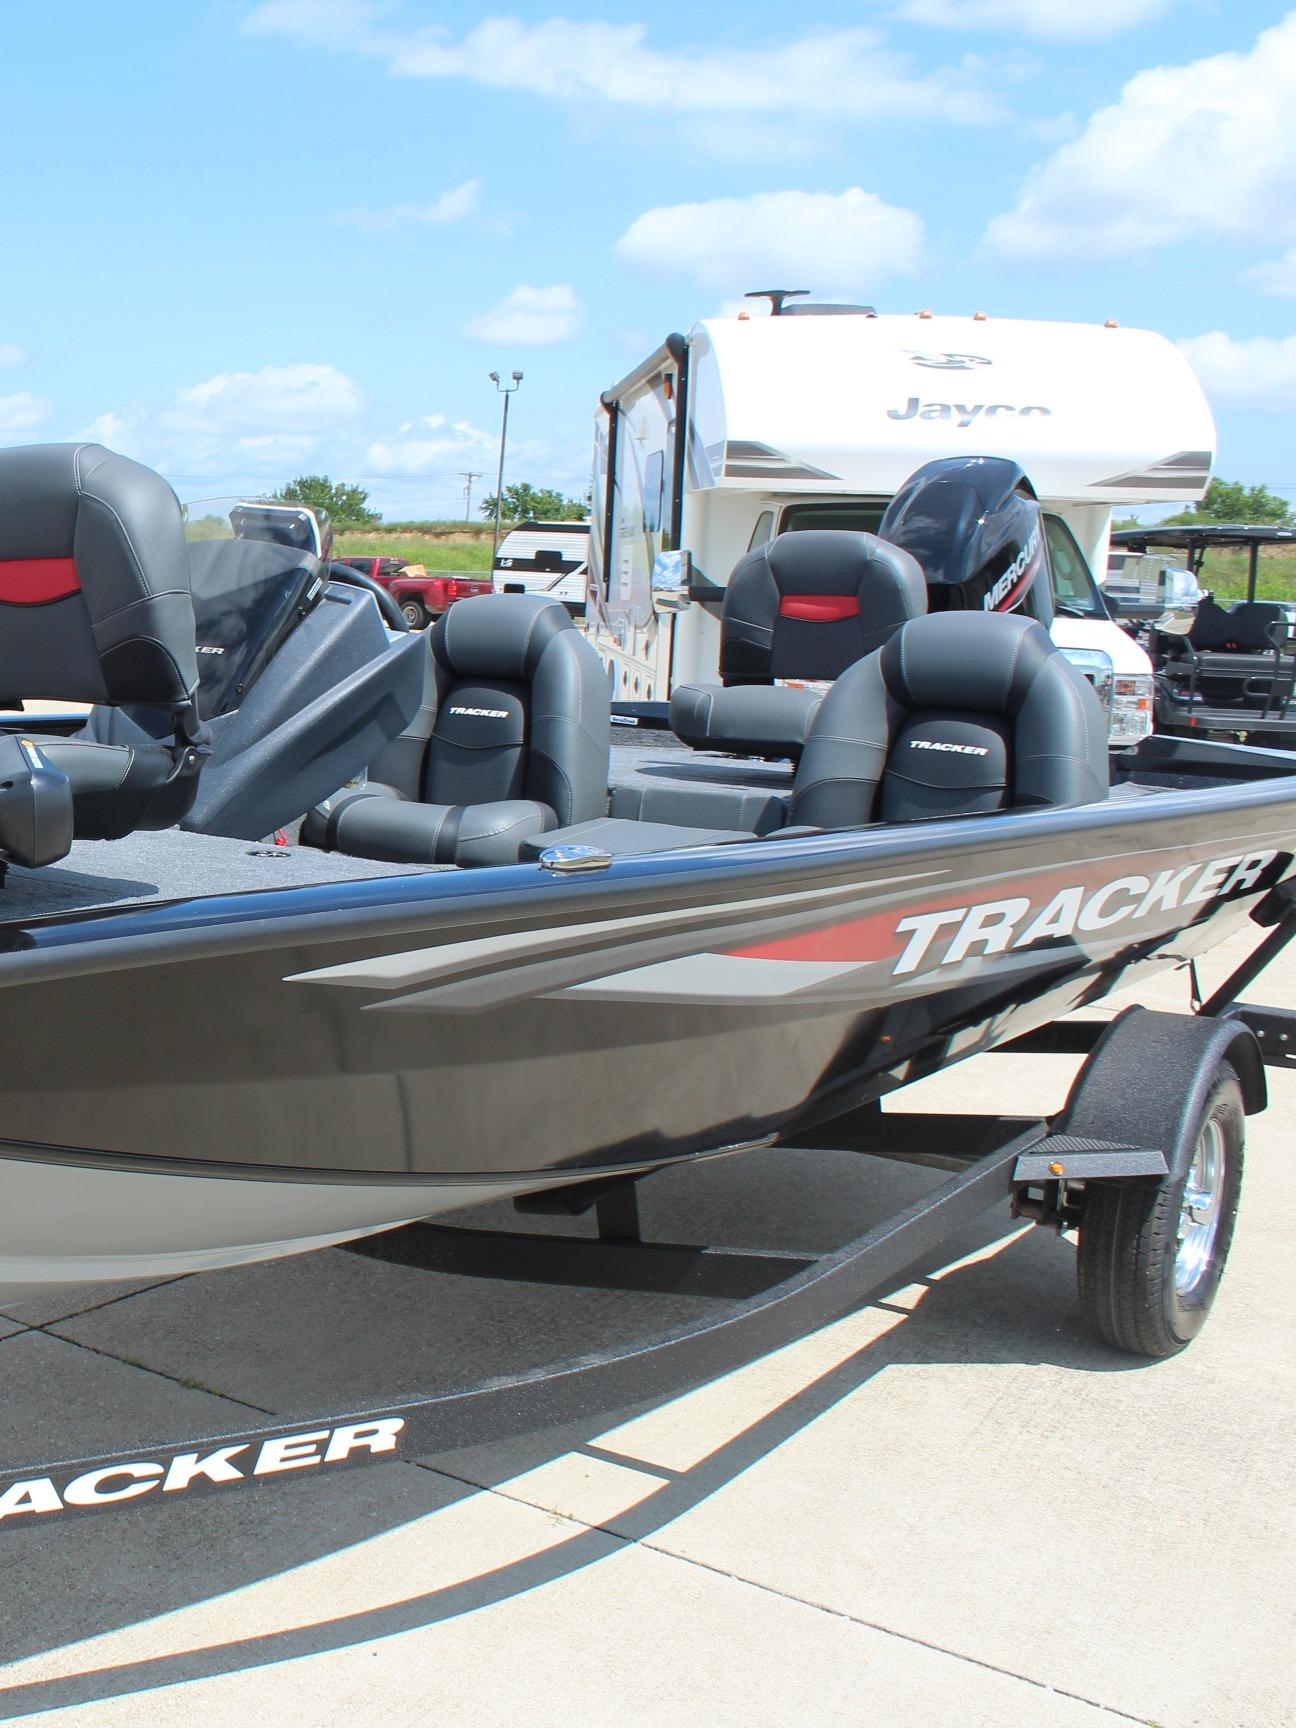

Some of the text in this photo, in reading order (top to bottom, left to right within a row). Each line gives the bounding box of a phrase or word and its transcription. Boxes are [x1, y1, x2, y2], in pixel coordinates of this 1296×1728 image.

[886, 397, 1052, 428] Jayco
[449, 706, 509, 718] TRACKER
[909, 740, 989, 756] TRACKER
[892, 849, 1278, 976] TRACKER
